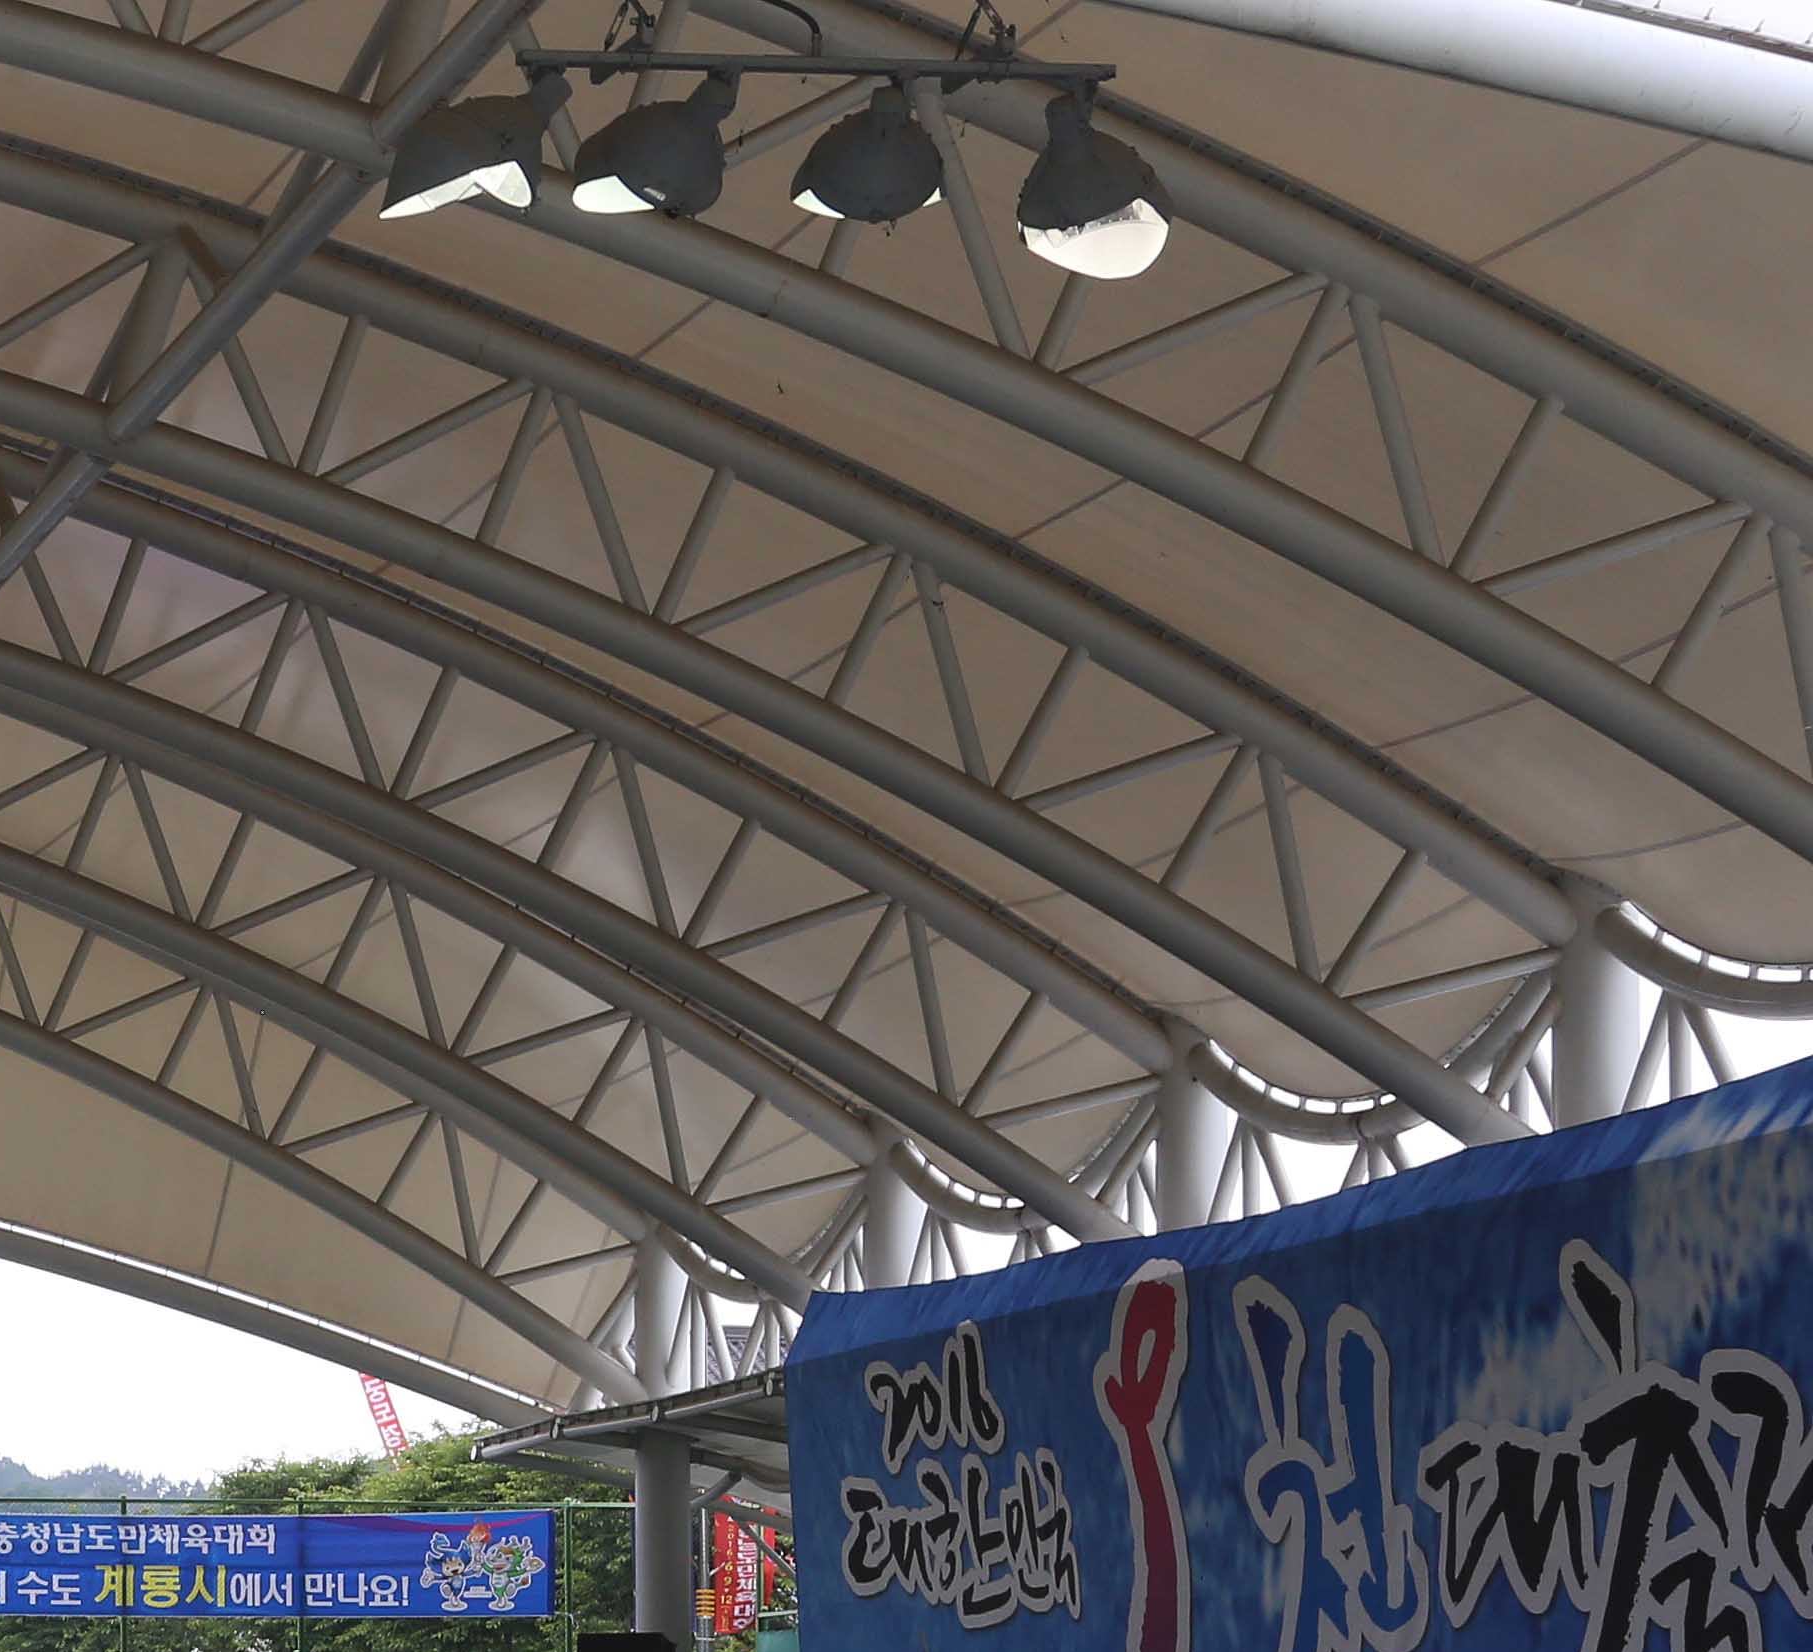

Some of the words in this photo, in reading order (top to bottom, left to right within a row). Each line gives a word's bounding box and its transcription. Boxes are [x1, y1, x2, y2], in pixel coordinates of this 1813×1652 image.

[869, 1332, 1000, 1462] 2016
[17, 1571, 82, 1606] 수도
[94, 1563, 293, 1609] 계룡시에서
[305, 1571, 410, 1608] 만나요!
[845, 1461, 1078, 1616] 대한민국
